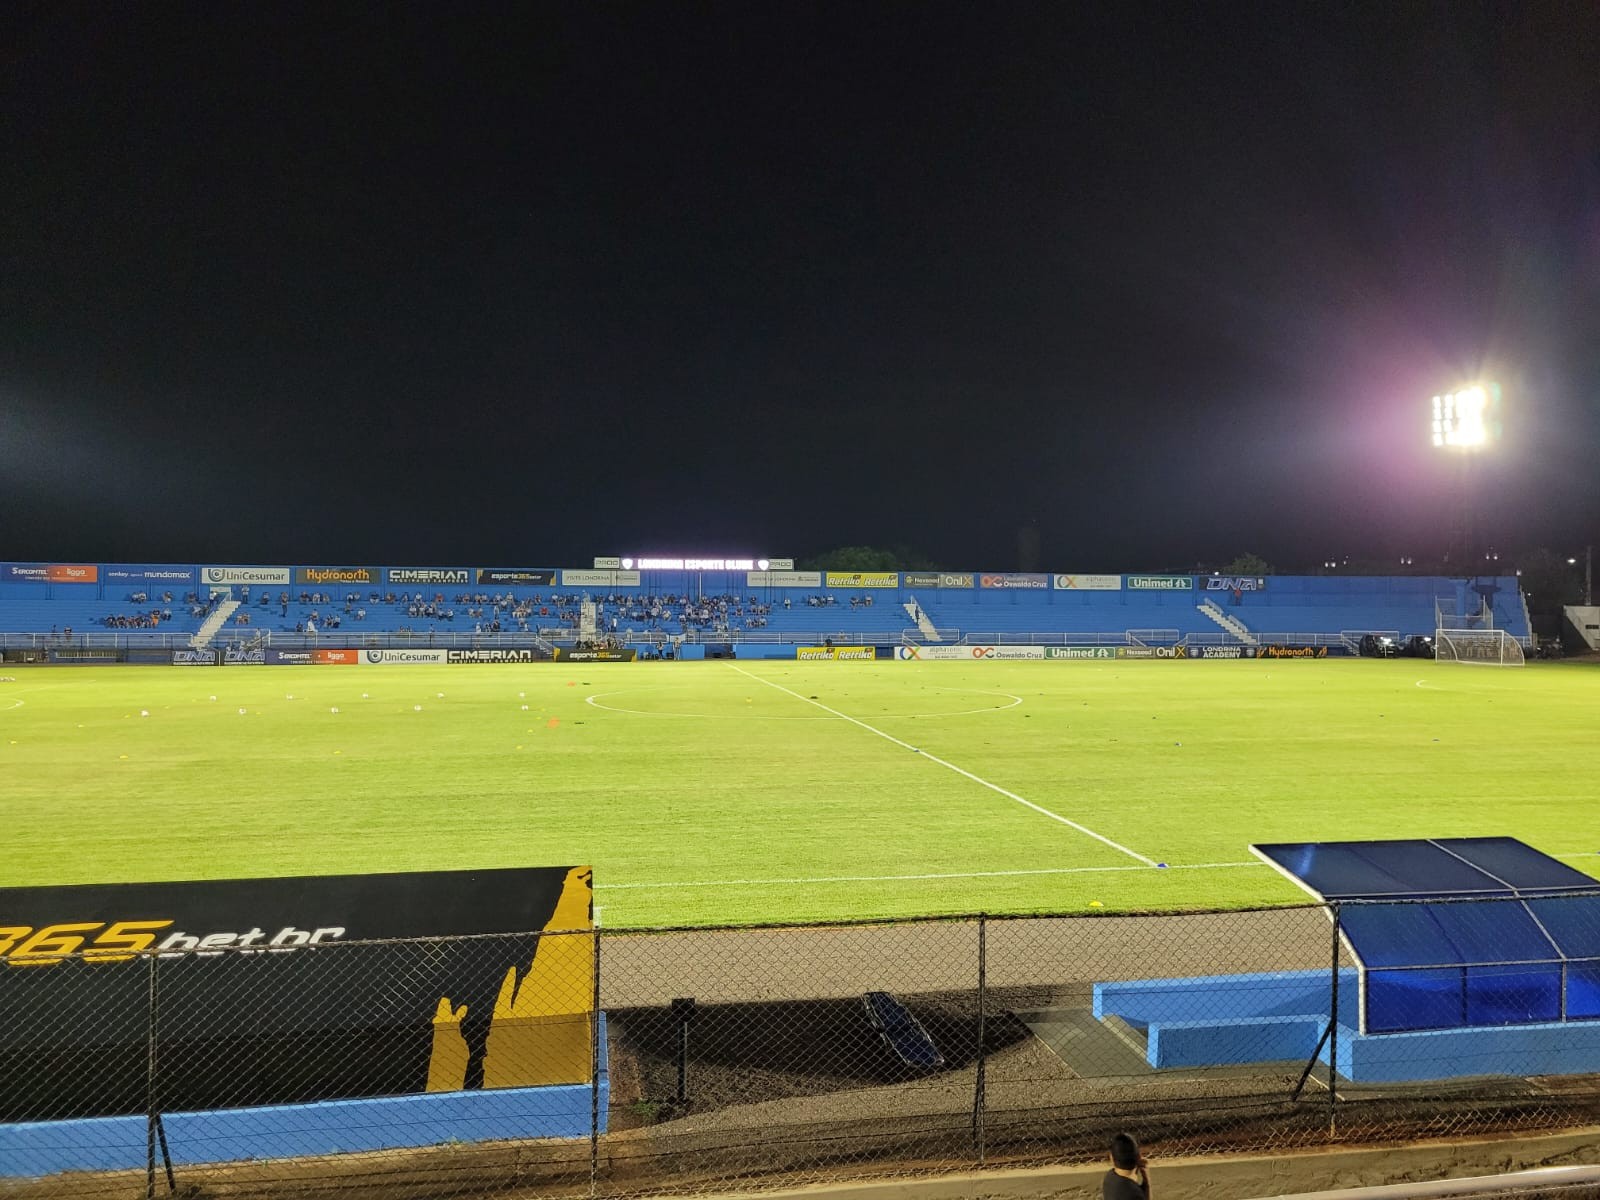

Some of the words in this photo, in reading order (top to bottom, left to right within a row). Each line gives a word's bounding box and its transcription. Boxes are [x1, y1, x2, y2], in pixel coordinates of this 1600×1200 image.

[144, 570, 191, 579] mundomax
[226, 571, 285, 581] UniCesumar
[306, 568, 370, 584] Hydronorth
[389, 569, 468, 580] CIMERIAN
[827, 575, 861, 586] Retriko
[863, 575, 897, 586] Retriko
[1003, 580, 1031, 588] Oswaldo
[1032, 580, 1048, 588] Cruz
[1133, 577, 1173, 588] Unimed
[1206, 577, 1257, 590] DNA
[173, 650, 216, 662] DNA
[224, 650, 266, 662] DNA
[384, 650, 441, 661] UniCesumar
[448, 649, 532, 660] CIMERIAN
[799, 651, 835, 660] Retriko
[838, 650, 873, 660] Retriko
[996, 651, 1026, 659] Oswaldo
[1051, 648, 1095, 658] Unimed
[1268, 646, 1314, 659] Hydronorth
